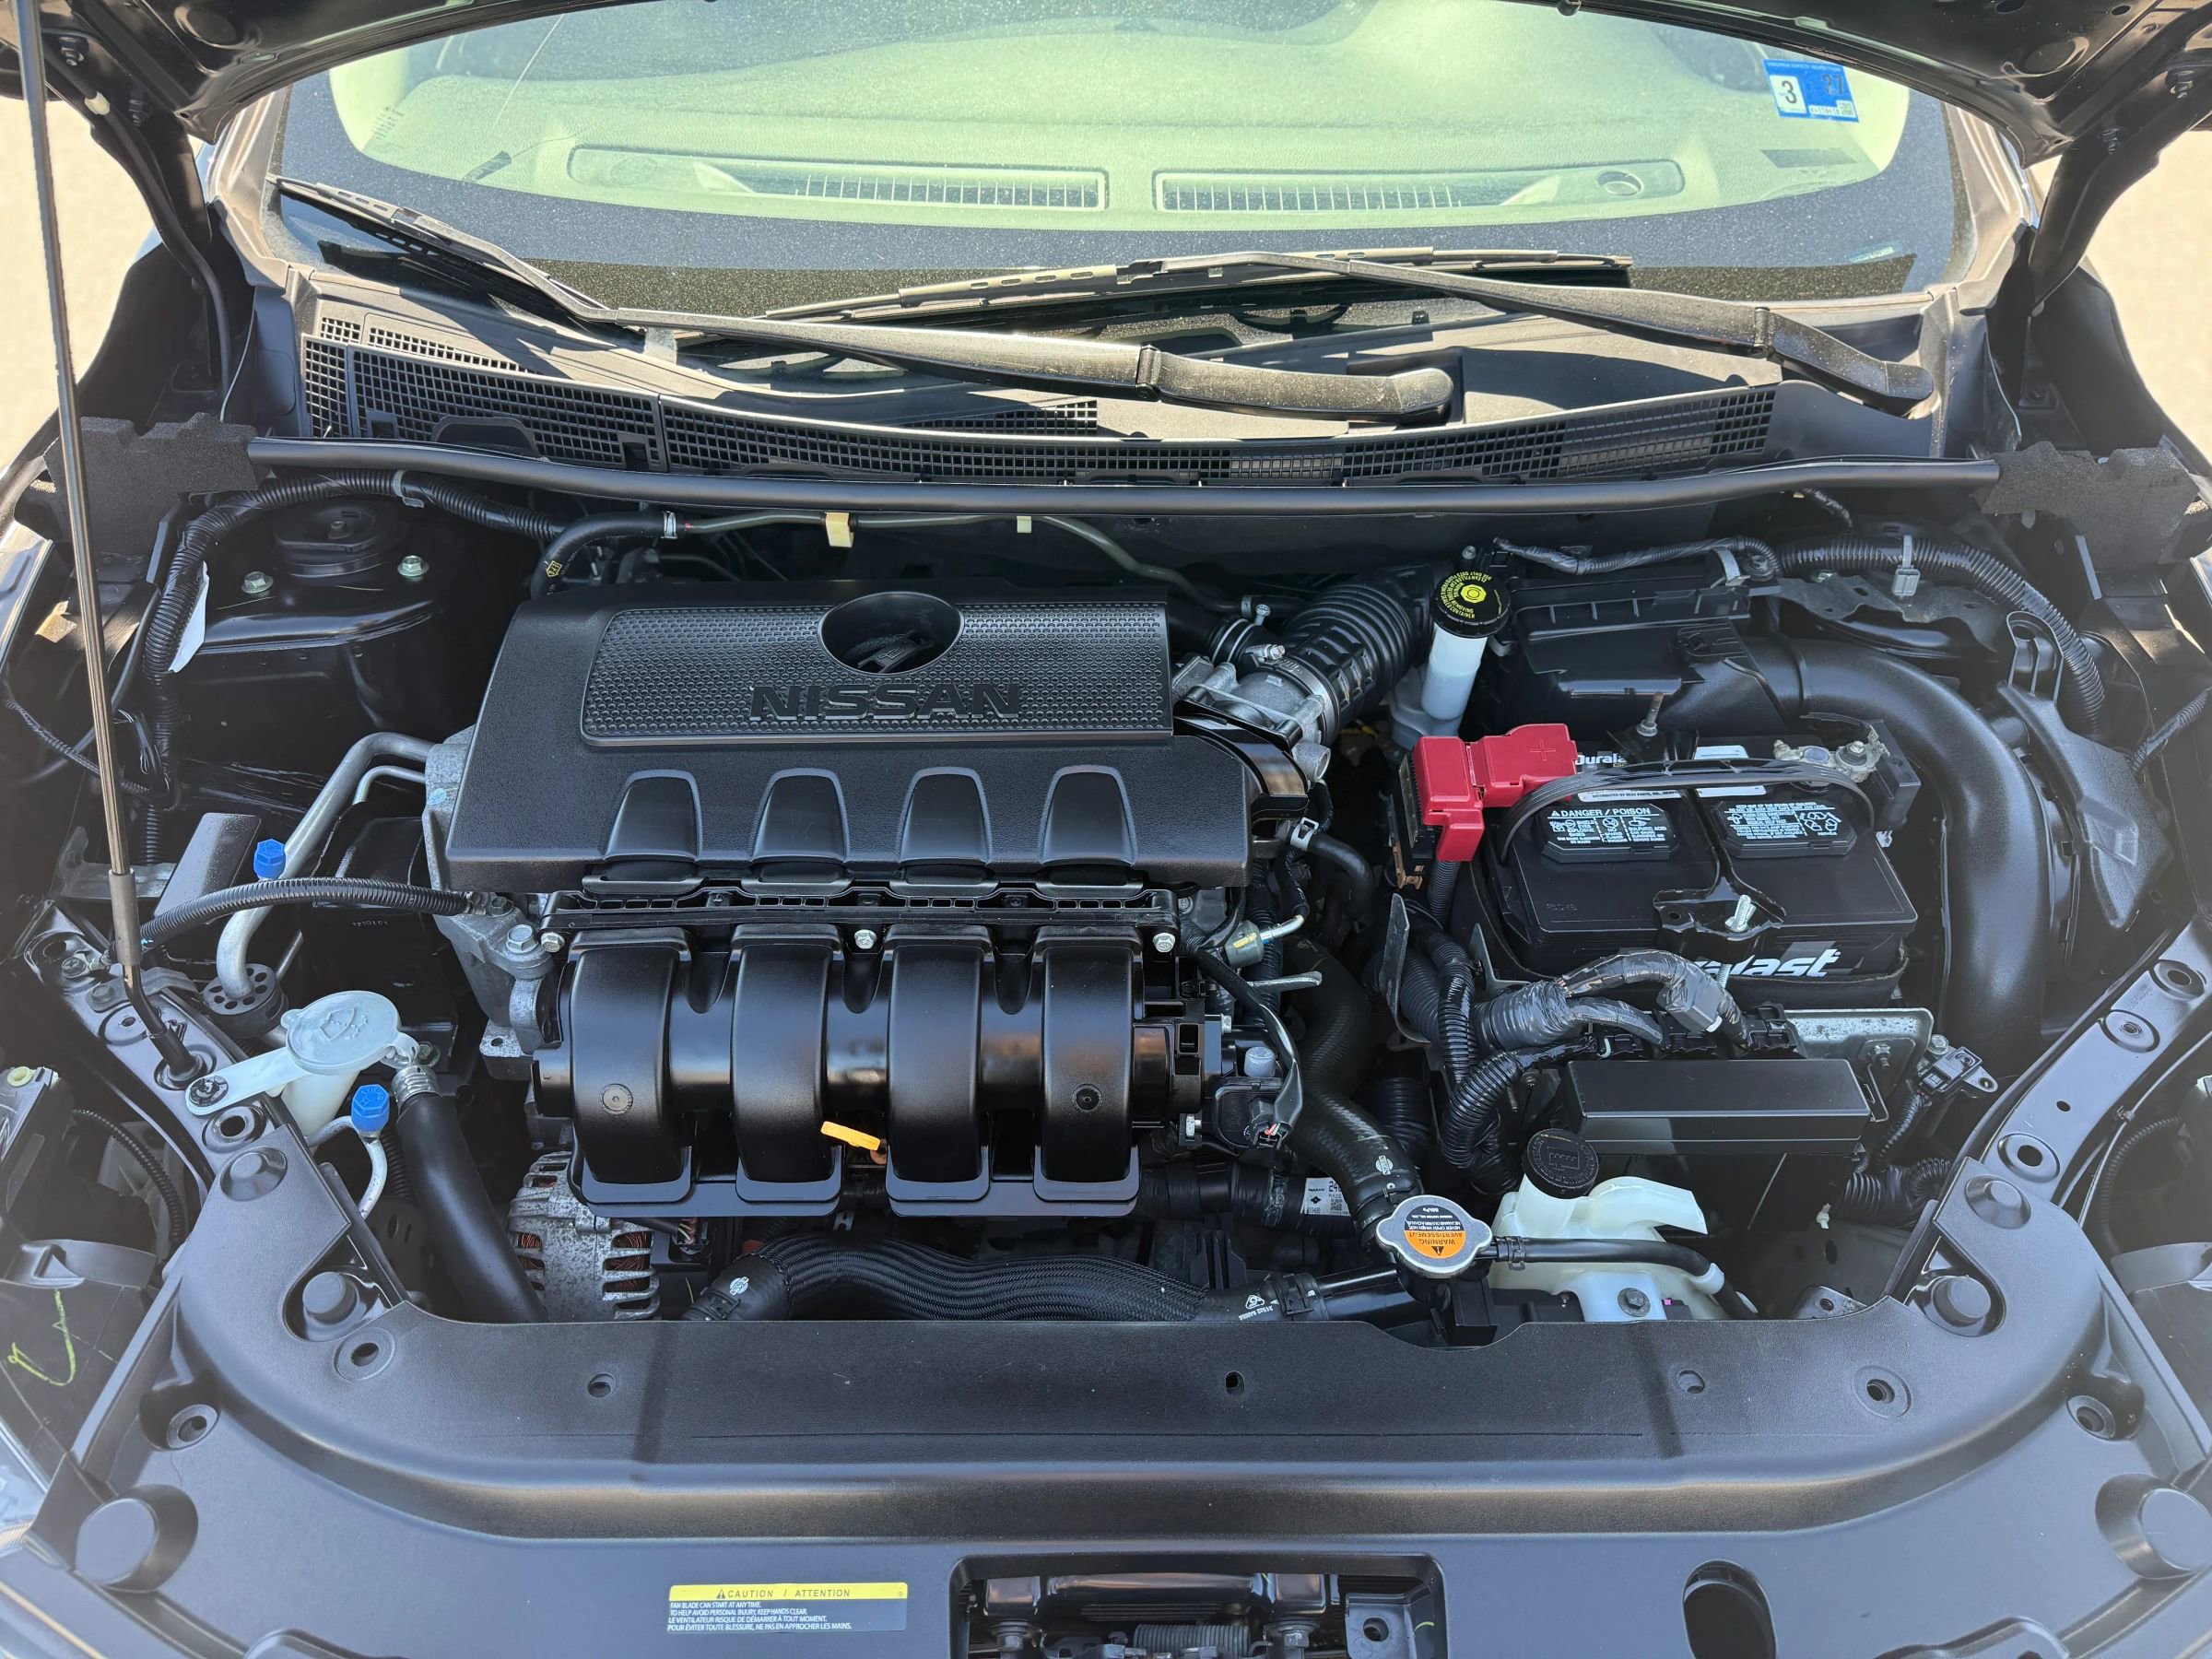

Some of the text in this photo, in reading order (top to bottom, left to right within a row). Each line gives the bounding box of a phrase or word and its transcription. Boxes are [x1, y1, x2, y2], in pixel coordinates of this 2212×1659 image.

[1781, 80, 1797, 104] 3
[749, 683, 1019, 721] NISSAN
[1575, 753, 1628, 765] Durala
[728, 1589, 850, 1598] CAUTION / ATTENTION
